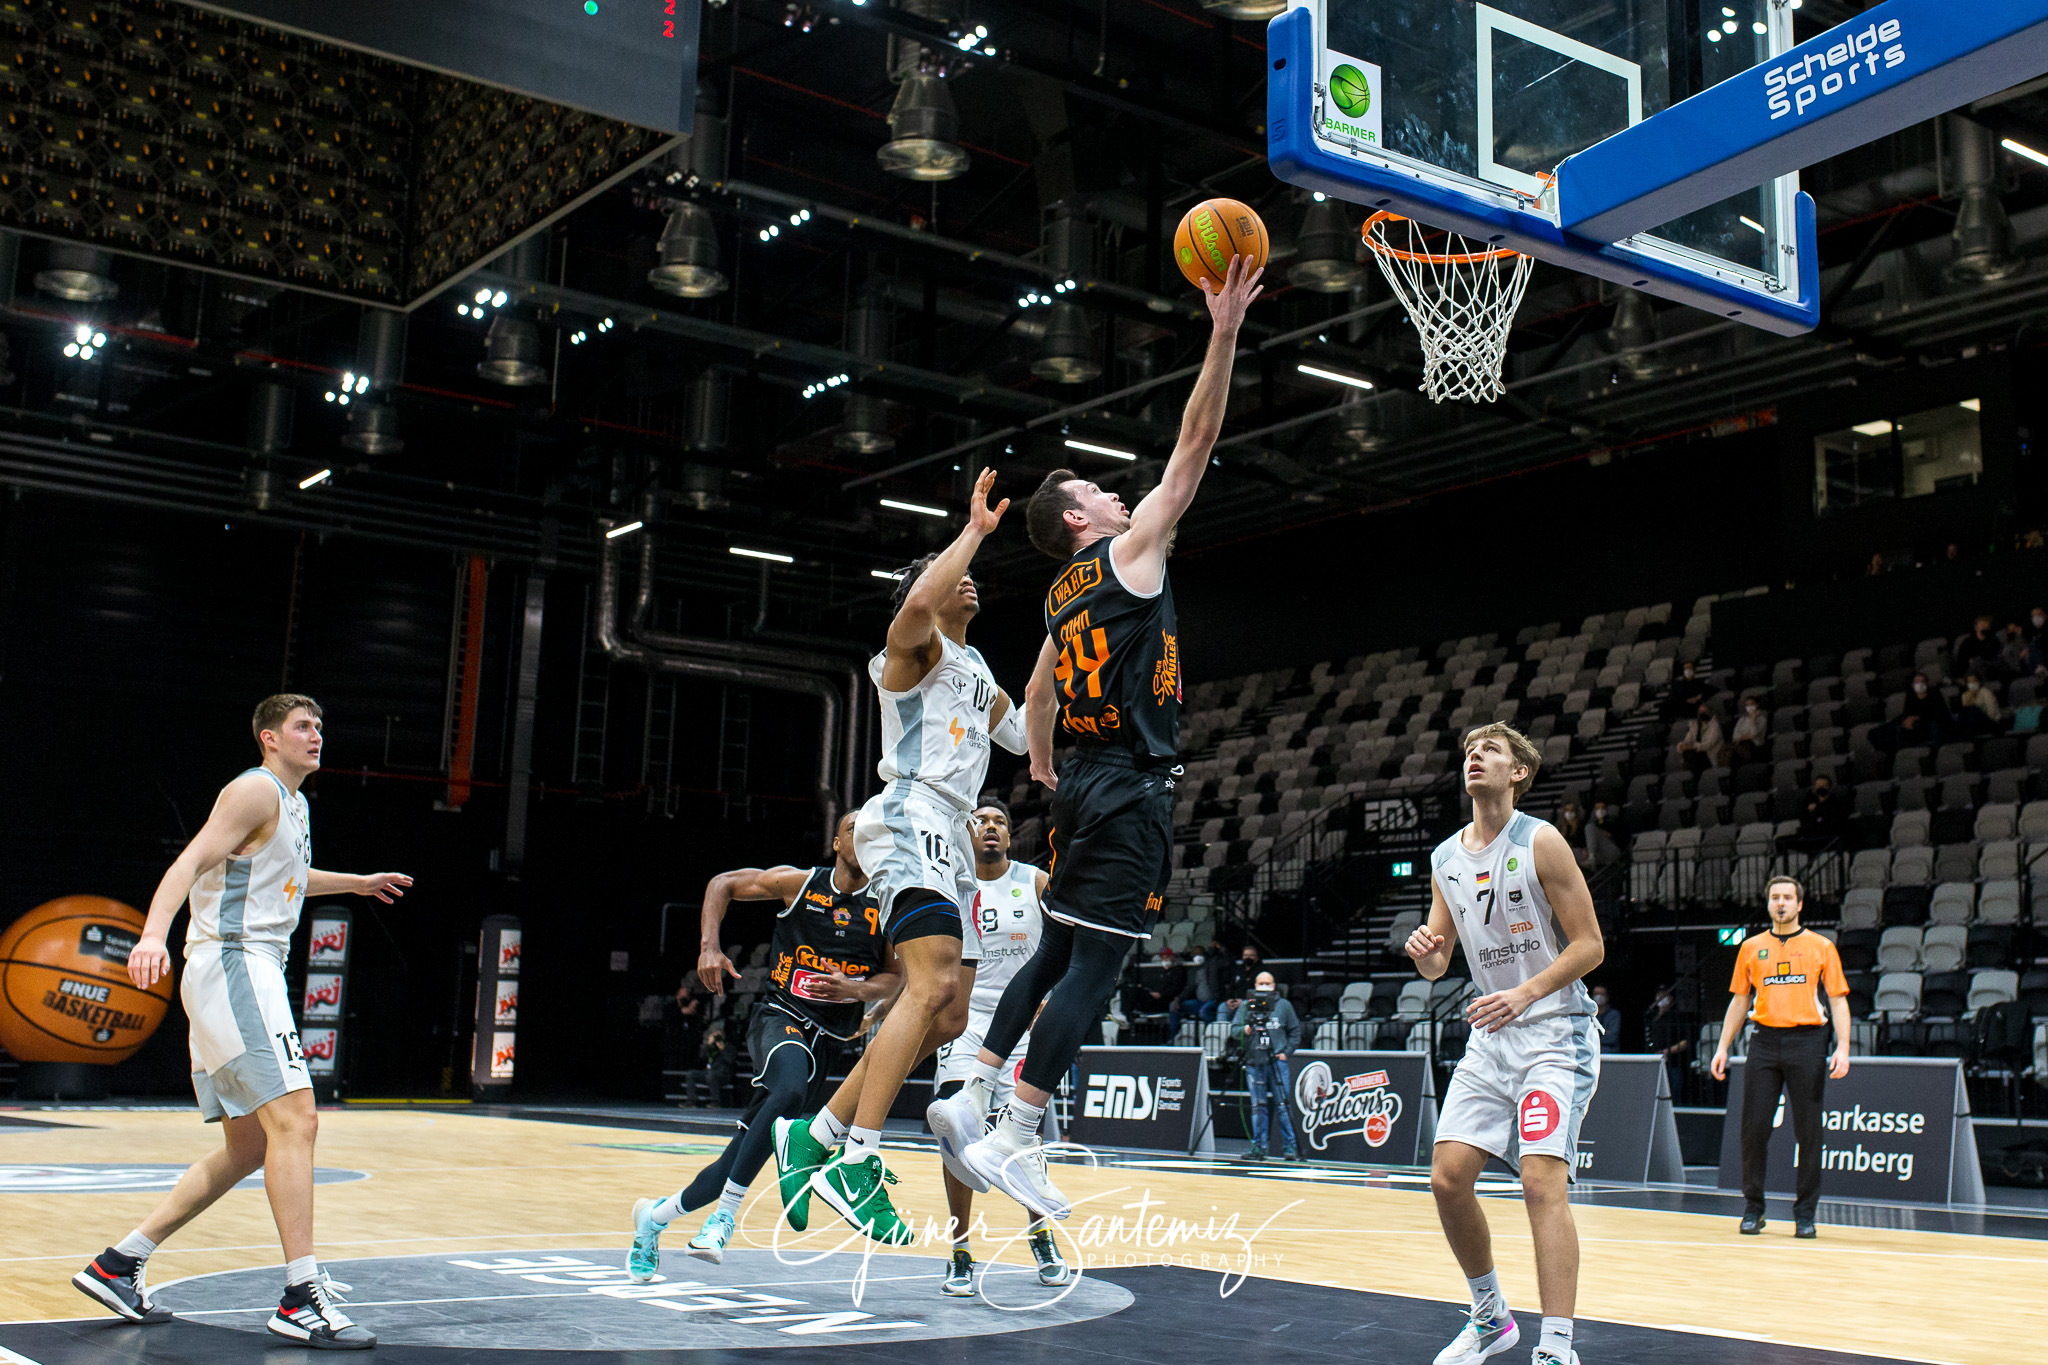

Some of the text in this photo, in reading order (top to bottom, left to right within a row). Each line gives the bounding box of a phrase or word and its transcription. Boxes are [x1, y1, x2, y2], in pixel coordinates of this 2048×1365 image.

[1764, 19, 1901, 95] Schelde
[1768, 43, 1906, 119] Sports
[1325, 118, 1376, 142] BARMER
[1195, 210, 1228, 272] Wilson
[1054, 566, 1091, 606] WAHL
[973, 673, 991, 712] 10
[921, 830, 951, 868] 10
[864, 907, 879, 936] 9
[982, 908, 999, 933] 9
[1476, 888, 1496, 926] 7
[1510, 920, 1534, 935] EMS
[1478, 938, 1541, 963] filmstudio
[1481, 955, 1516, 970] nürnberg
[60, 979, 109, 1003] #NUE
[42, 990, 146, 1031] BASKETBALL
[1083, 1074, 1153, 1120] EMS
[1304, 1083, 1401, 1132] Falcons
[1822, 1104, 1925, 1134] arkasse
